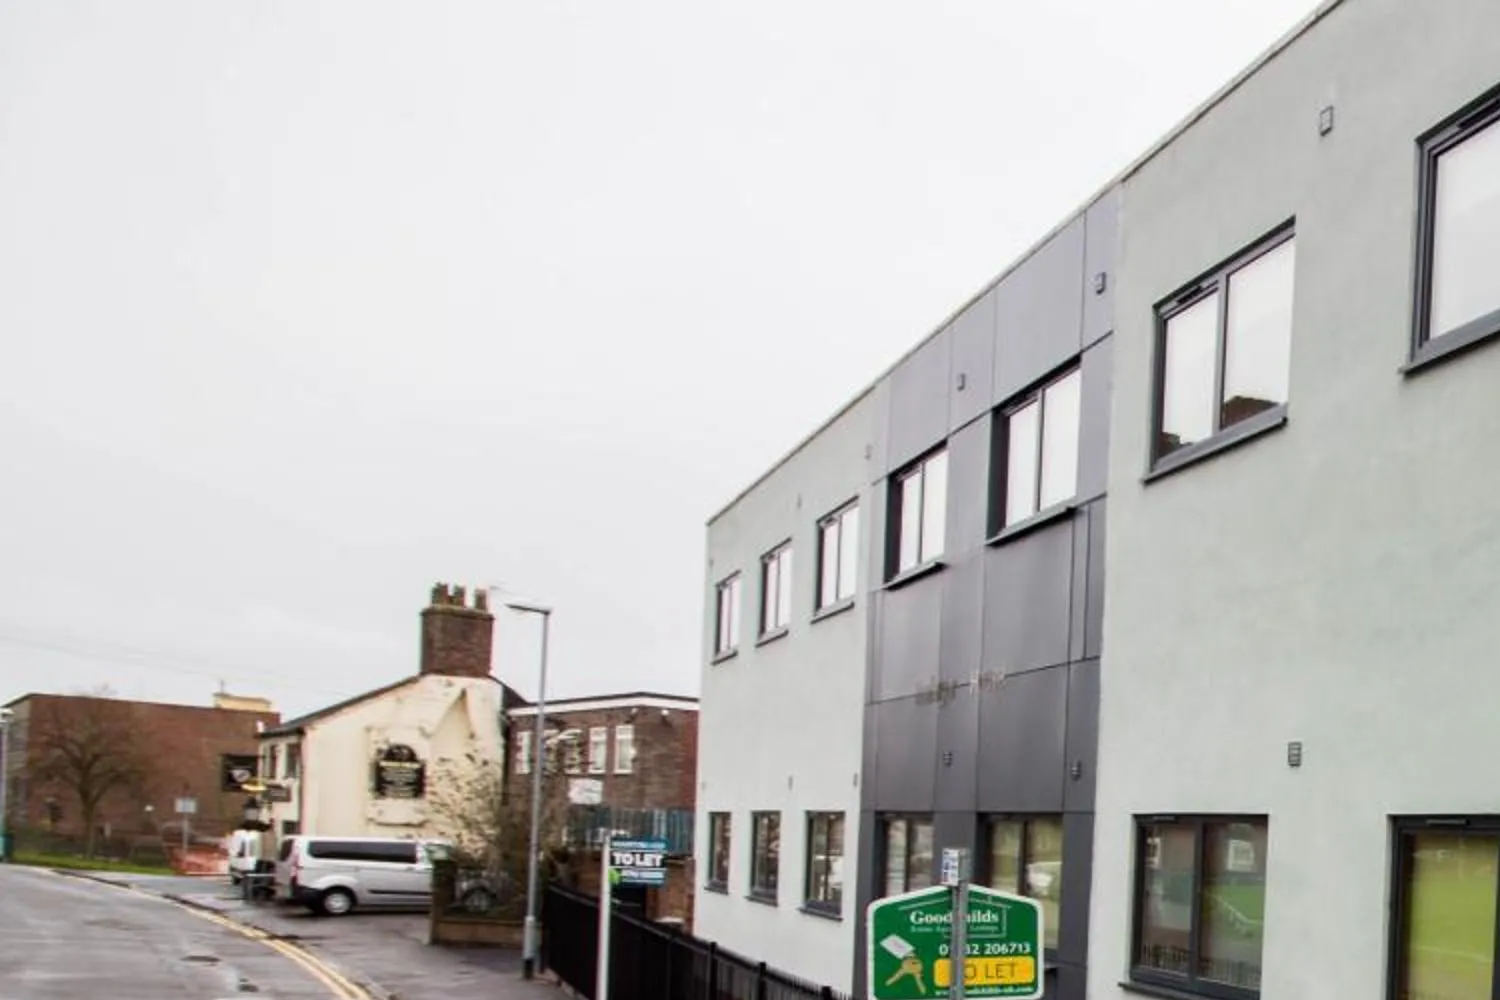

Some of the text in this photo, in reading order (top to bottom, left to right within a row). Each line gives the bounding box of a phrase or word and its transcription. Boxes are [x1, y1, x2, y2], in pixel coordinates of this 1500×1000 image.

[612, 852, 663, 867] TO LET
[909, 910, 999, 925] Goodilds
[984, 941, 1031, 955] 206713
[985, 961, 1018, 980] LET
